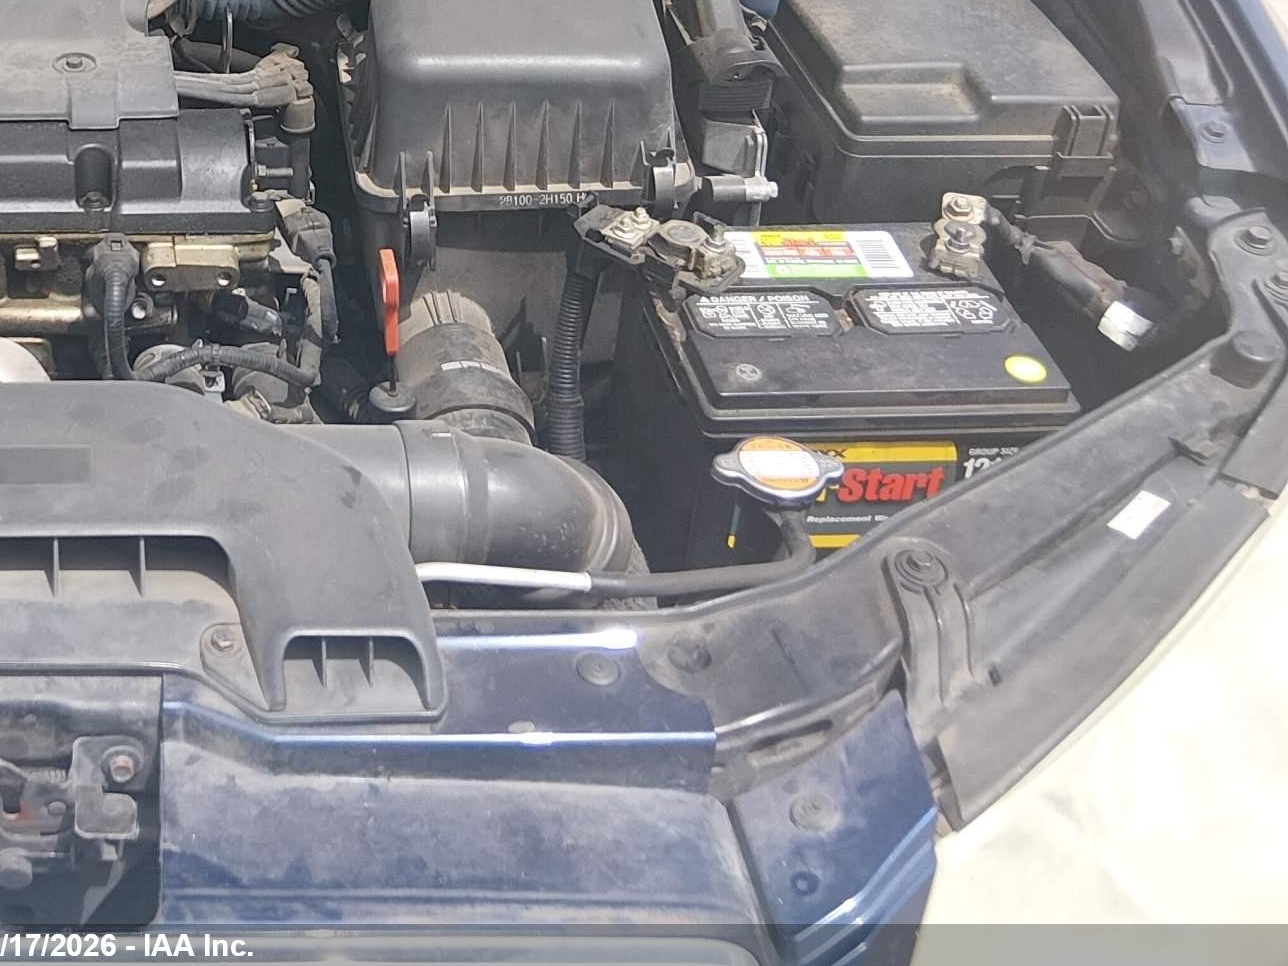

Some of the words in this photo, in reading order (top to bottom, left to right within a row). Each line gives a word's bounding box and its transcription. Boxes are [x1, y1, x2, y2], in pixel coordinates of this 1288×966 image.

[767, 294, 810, 302] POISON
[968, 448, 999, 456] GROUP
[806, 515, 872, 523] Replacement
